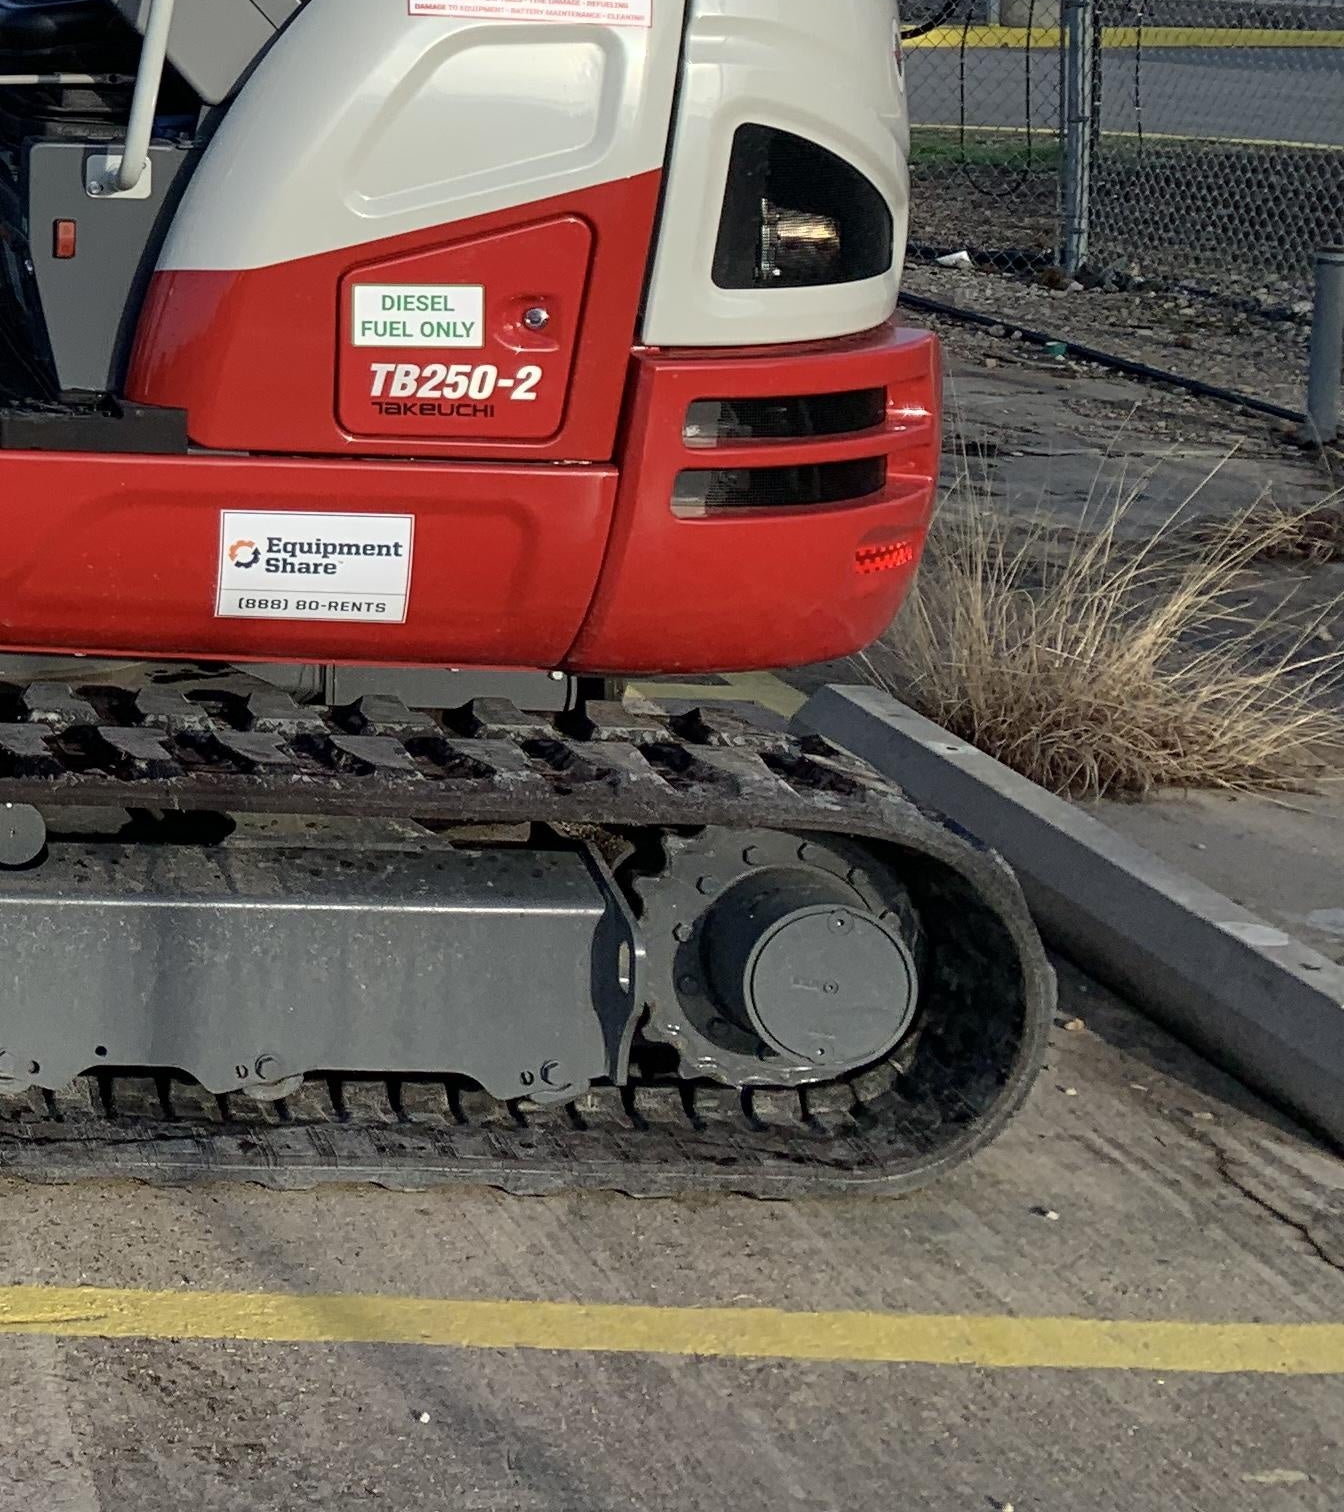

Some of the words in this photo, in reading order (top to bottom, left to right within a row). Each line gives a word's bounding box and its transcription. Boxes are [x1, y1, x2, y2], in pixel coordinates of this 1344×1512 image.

[460, 5, 505, 13] EQUIPMENT
[511, 7, 544, 15] BATTERY
[546, 9, 601, 19] MAINTENANCE
[381, 294, 455, 312] DIESEL
[361, 320, 413, 337] FUEL
[420, 321, 474, 338] ONLY
[370, 363, 542, 401] TB250-2
[371, 402, 495, 418] TAKEUCHI
[266, 537, 403, 558] Equipment
[265, 557, 337, 575] Share
[238, 597, 289, 611] (888)
[295, 600, 387, 613] 80-RENTS
